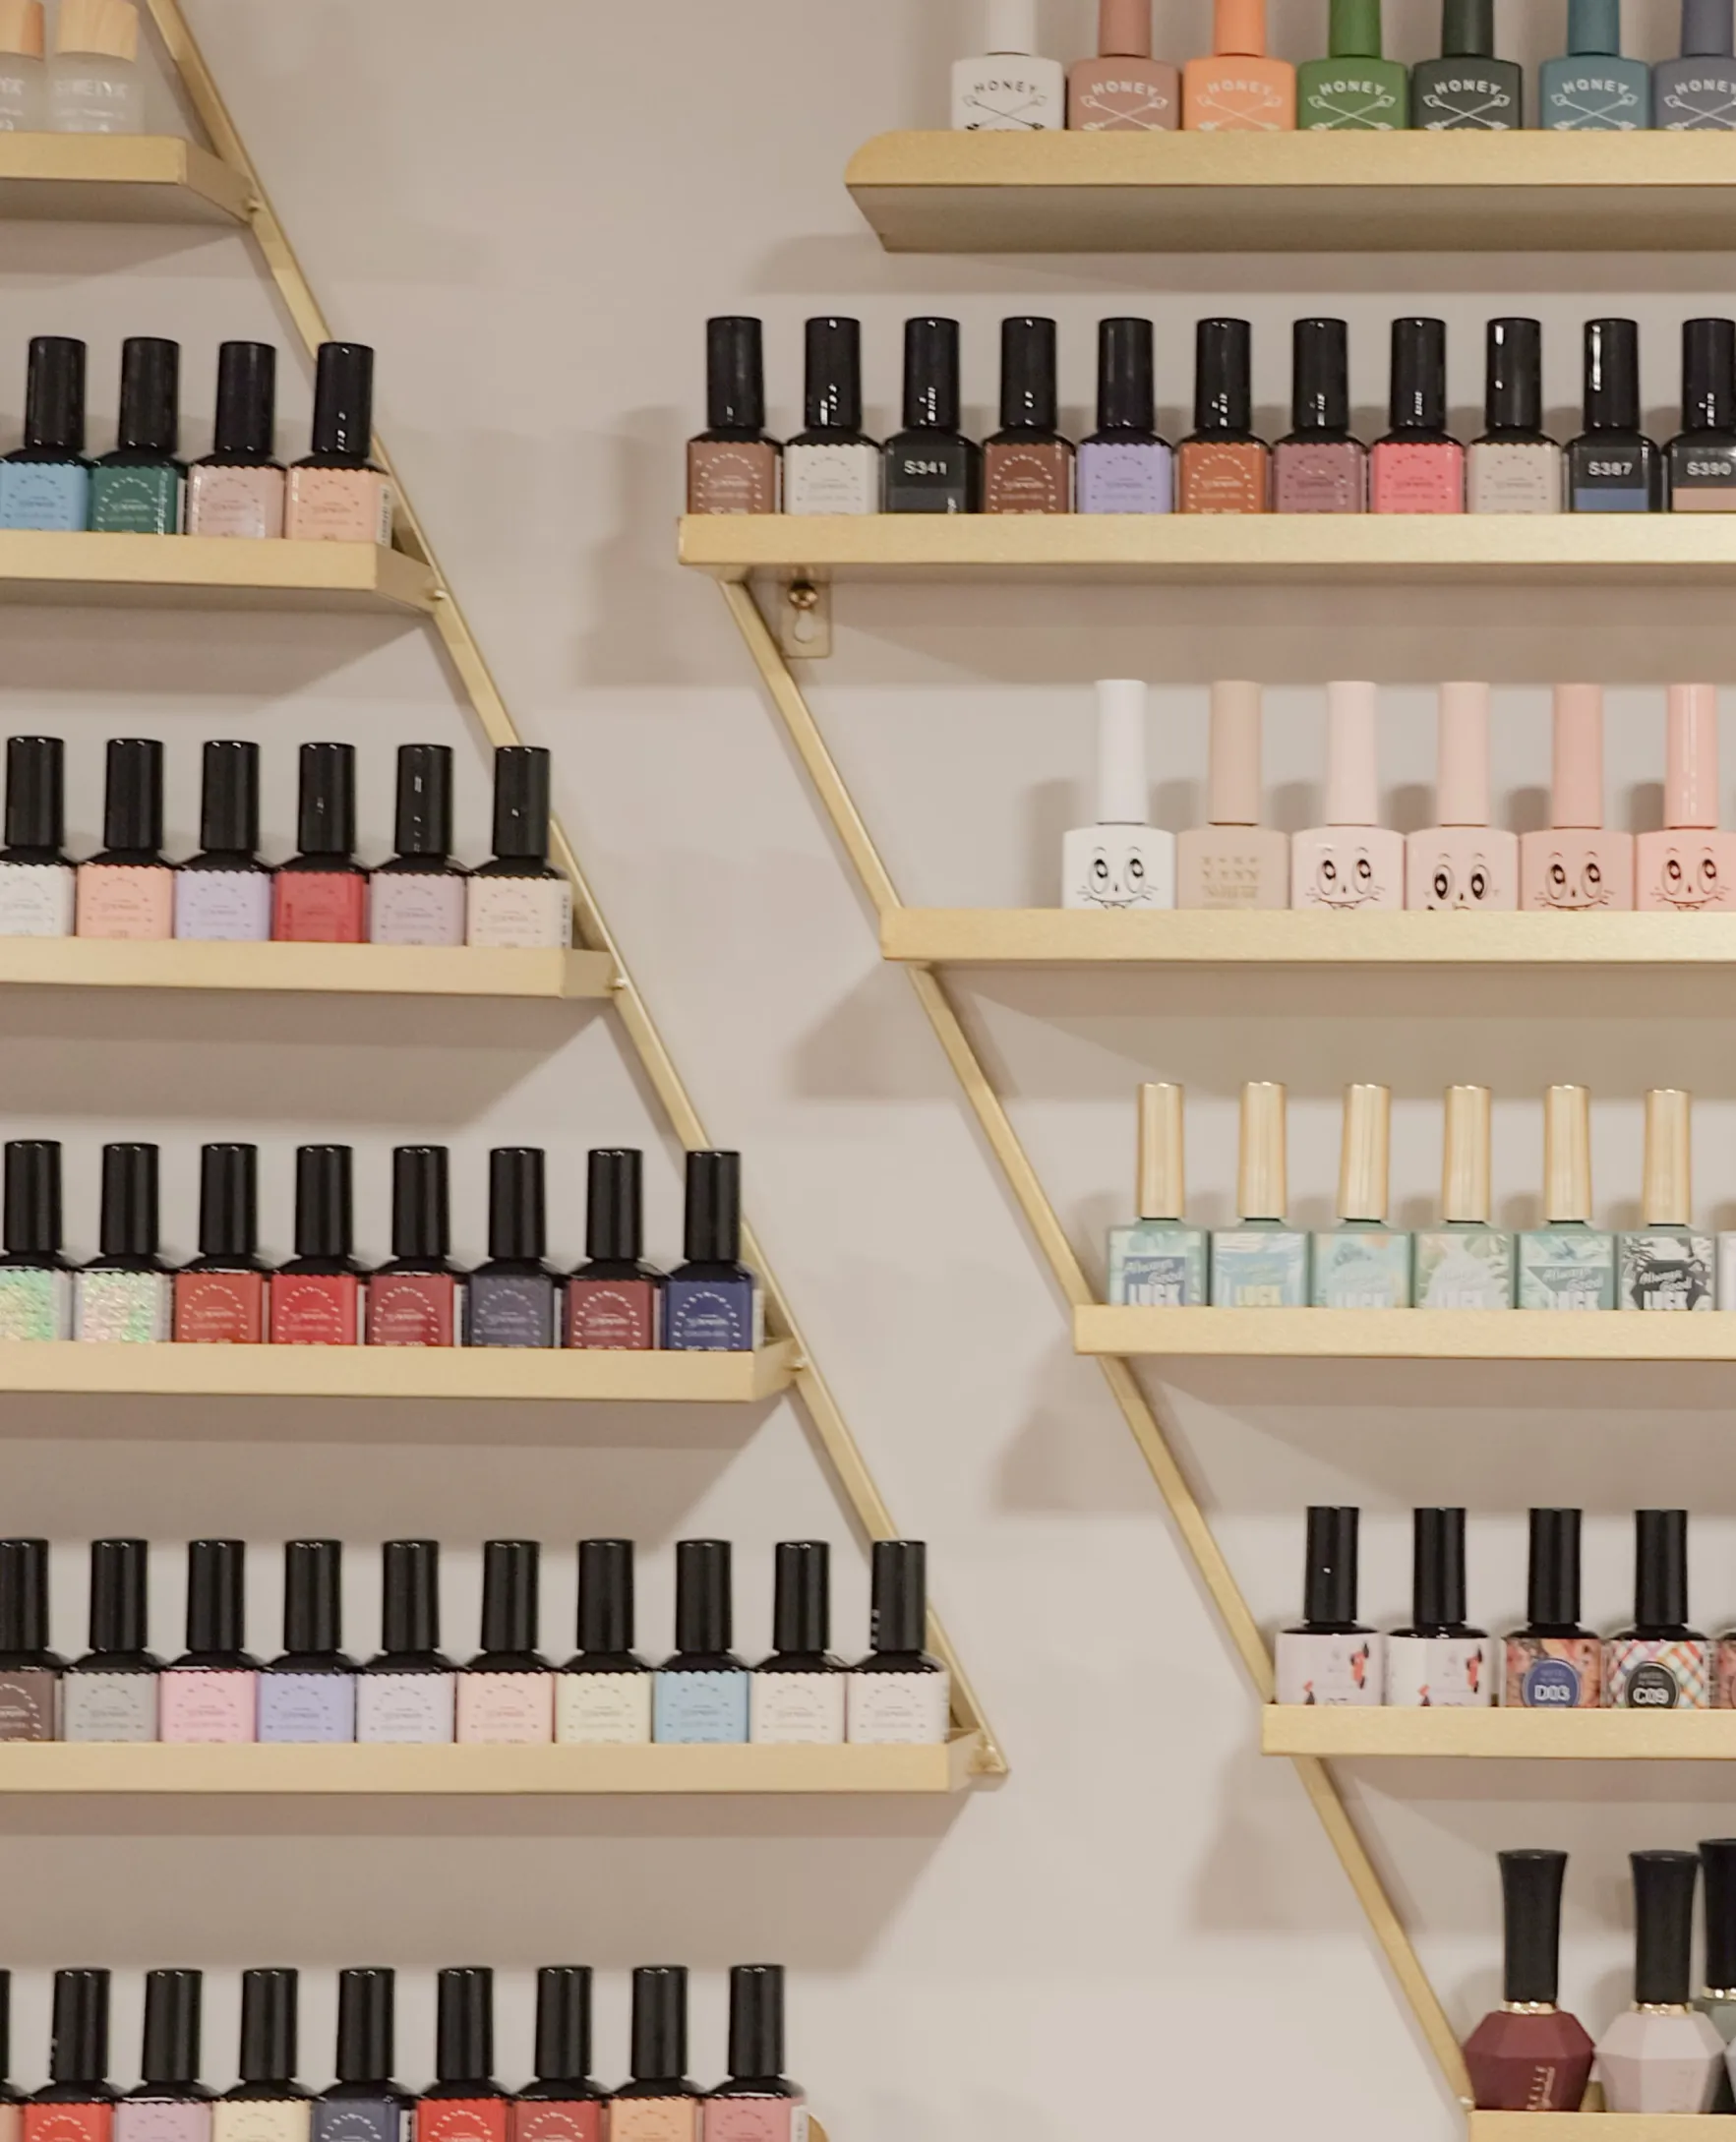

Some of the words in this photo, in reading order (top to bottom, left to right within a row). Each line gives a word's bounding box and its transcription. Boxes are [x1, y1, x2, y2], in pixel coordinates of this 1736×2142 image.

[973, 80, 1039, 95] HONEY
[1091, 79, 1159, 96] HONEY
[1207, 79, 1274, 96] HONEY
[1319, 79, 1386, 96] HONEY
[1433, 79, 1502, 96] HONEY
[1561, 79, 1631, 96] HONEY
[903, 459, 947, 476] S341
